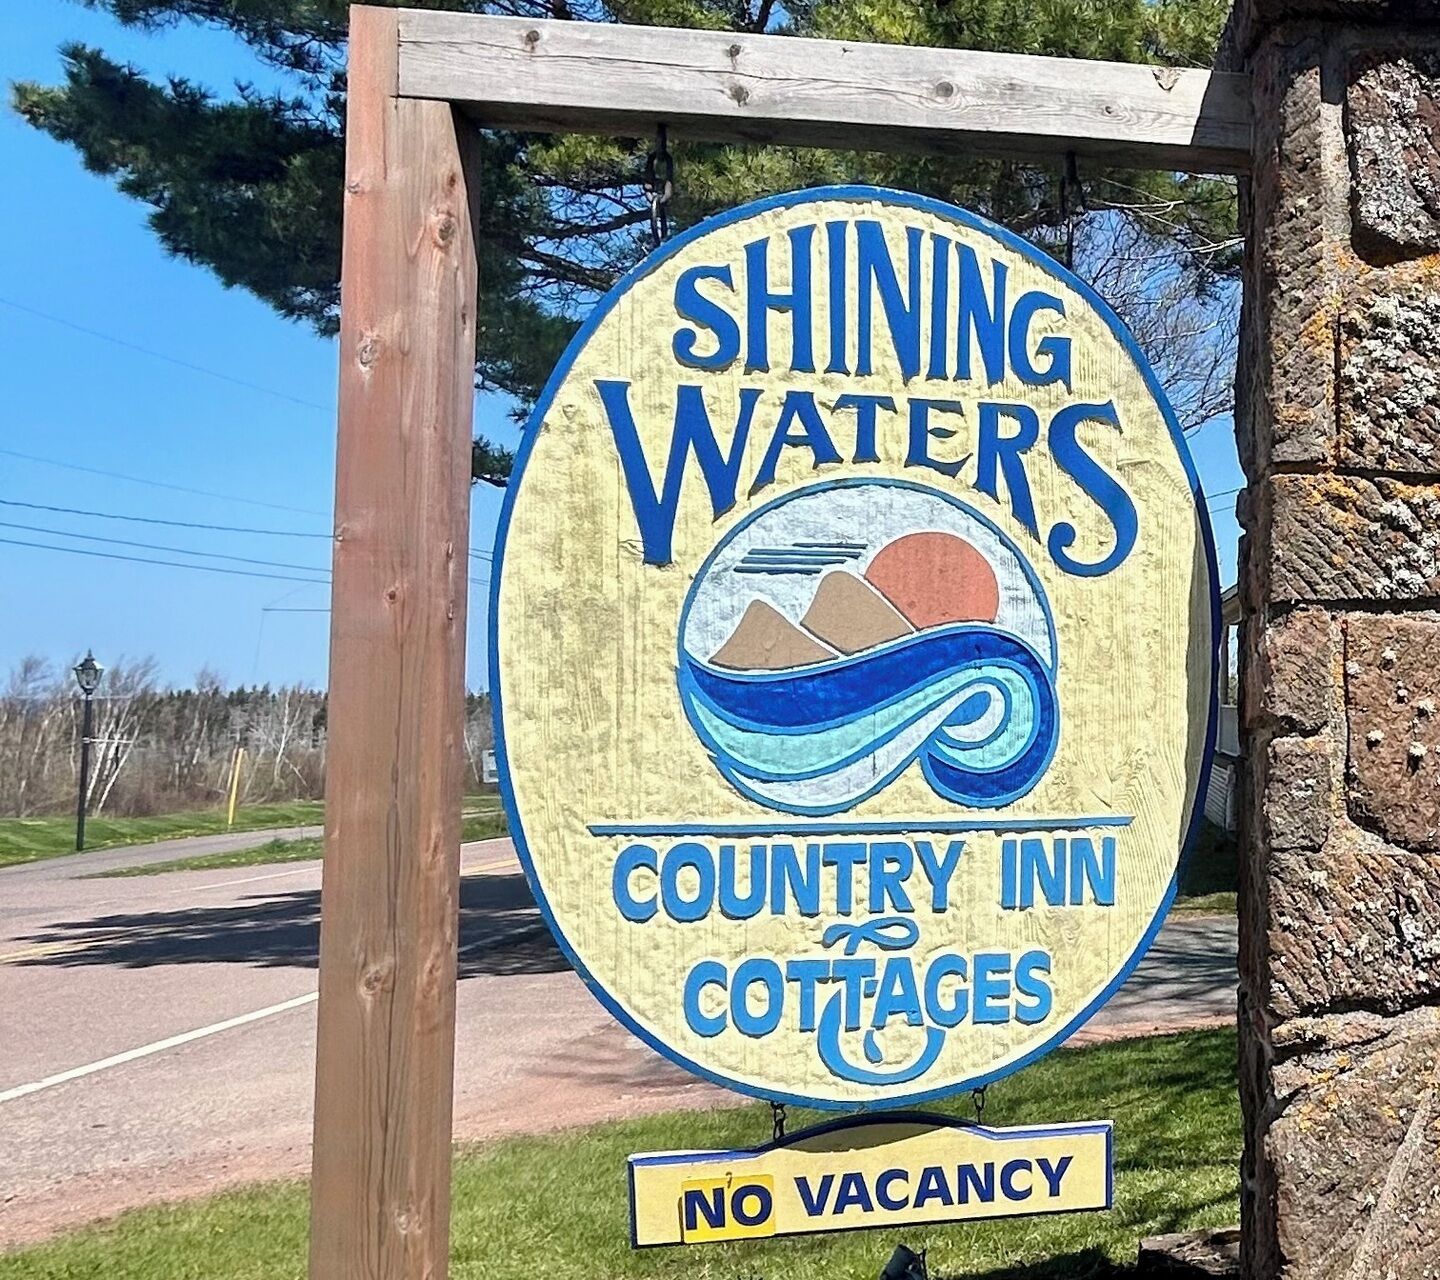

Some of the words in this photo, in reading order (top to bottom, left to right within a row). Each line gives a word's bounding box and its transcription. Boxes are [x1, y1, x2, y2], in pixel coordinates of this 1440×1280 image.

[673, 220, 1072, 394] SHINING
[594, 380, 1138, 577] WATERS
[612, 841, 964, 923] COUNTRY
[1002, 838, 1116, 909] INN
[684, 950, 1053, 1037] COTTAGES
[683, 1183, 773, 1230] NO
[794, 1156, 1073, 1217] VACANCY
